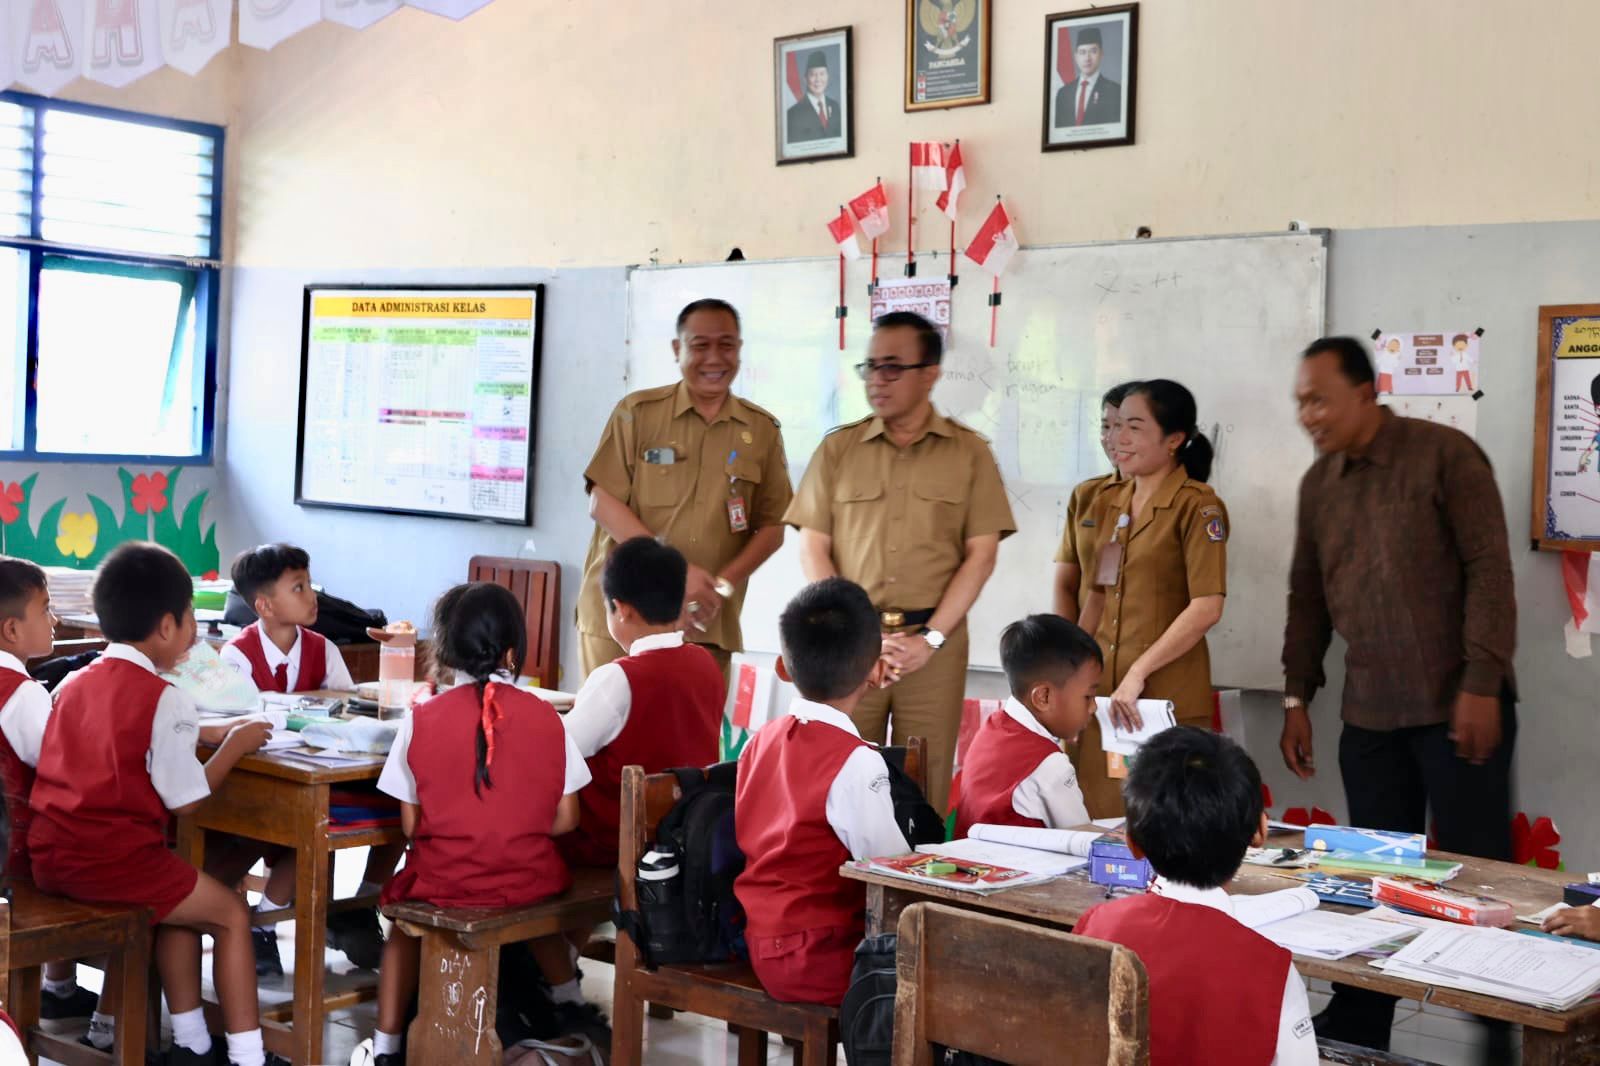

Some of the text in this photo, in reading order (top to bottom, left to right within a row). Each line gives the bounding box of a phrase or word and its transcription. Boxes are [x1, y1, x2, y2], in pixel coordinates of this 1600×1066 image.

[351, 302, 487, 313] DATA ADMINISTRASI KELAS
[1568, 344, 1600, 353] ANGG
